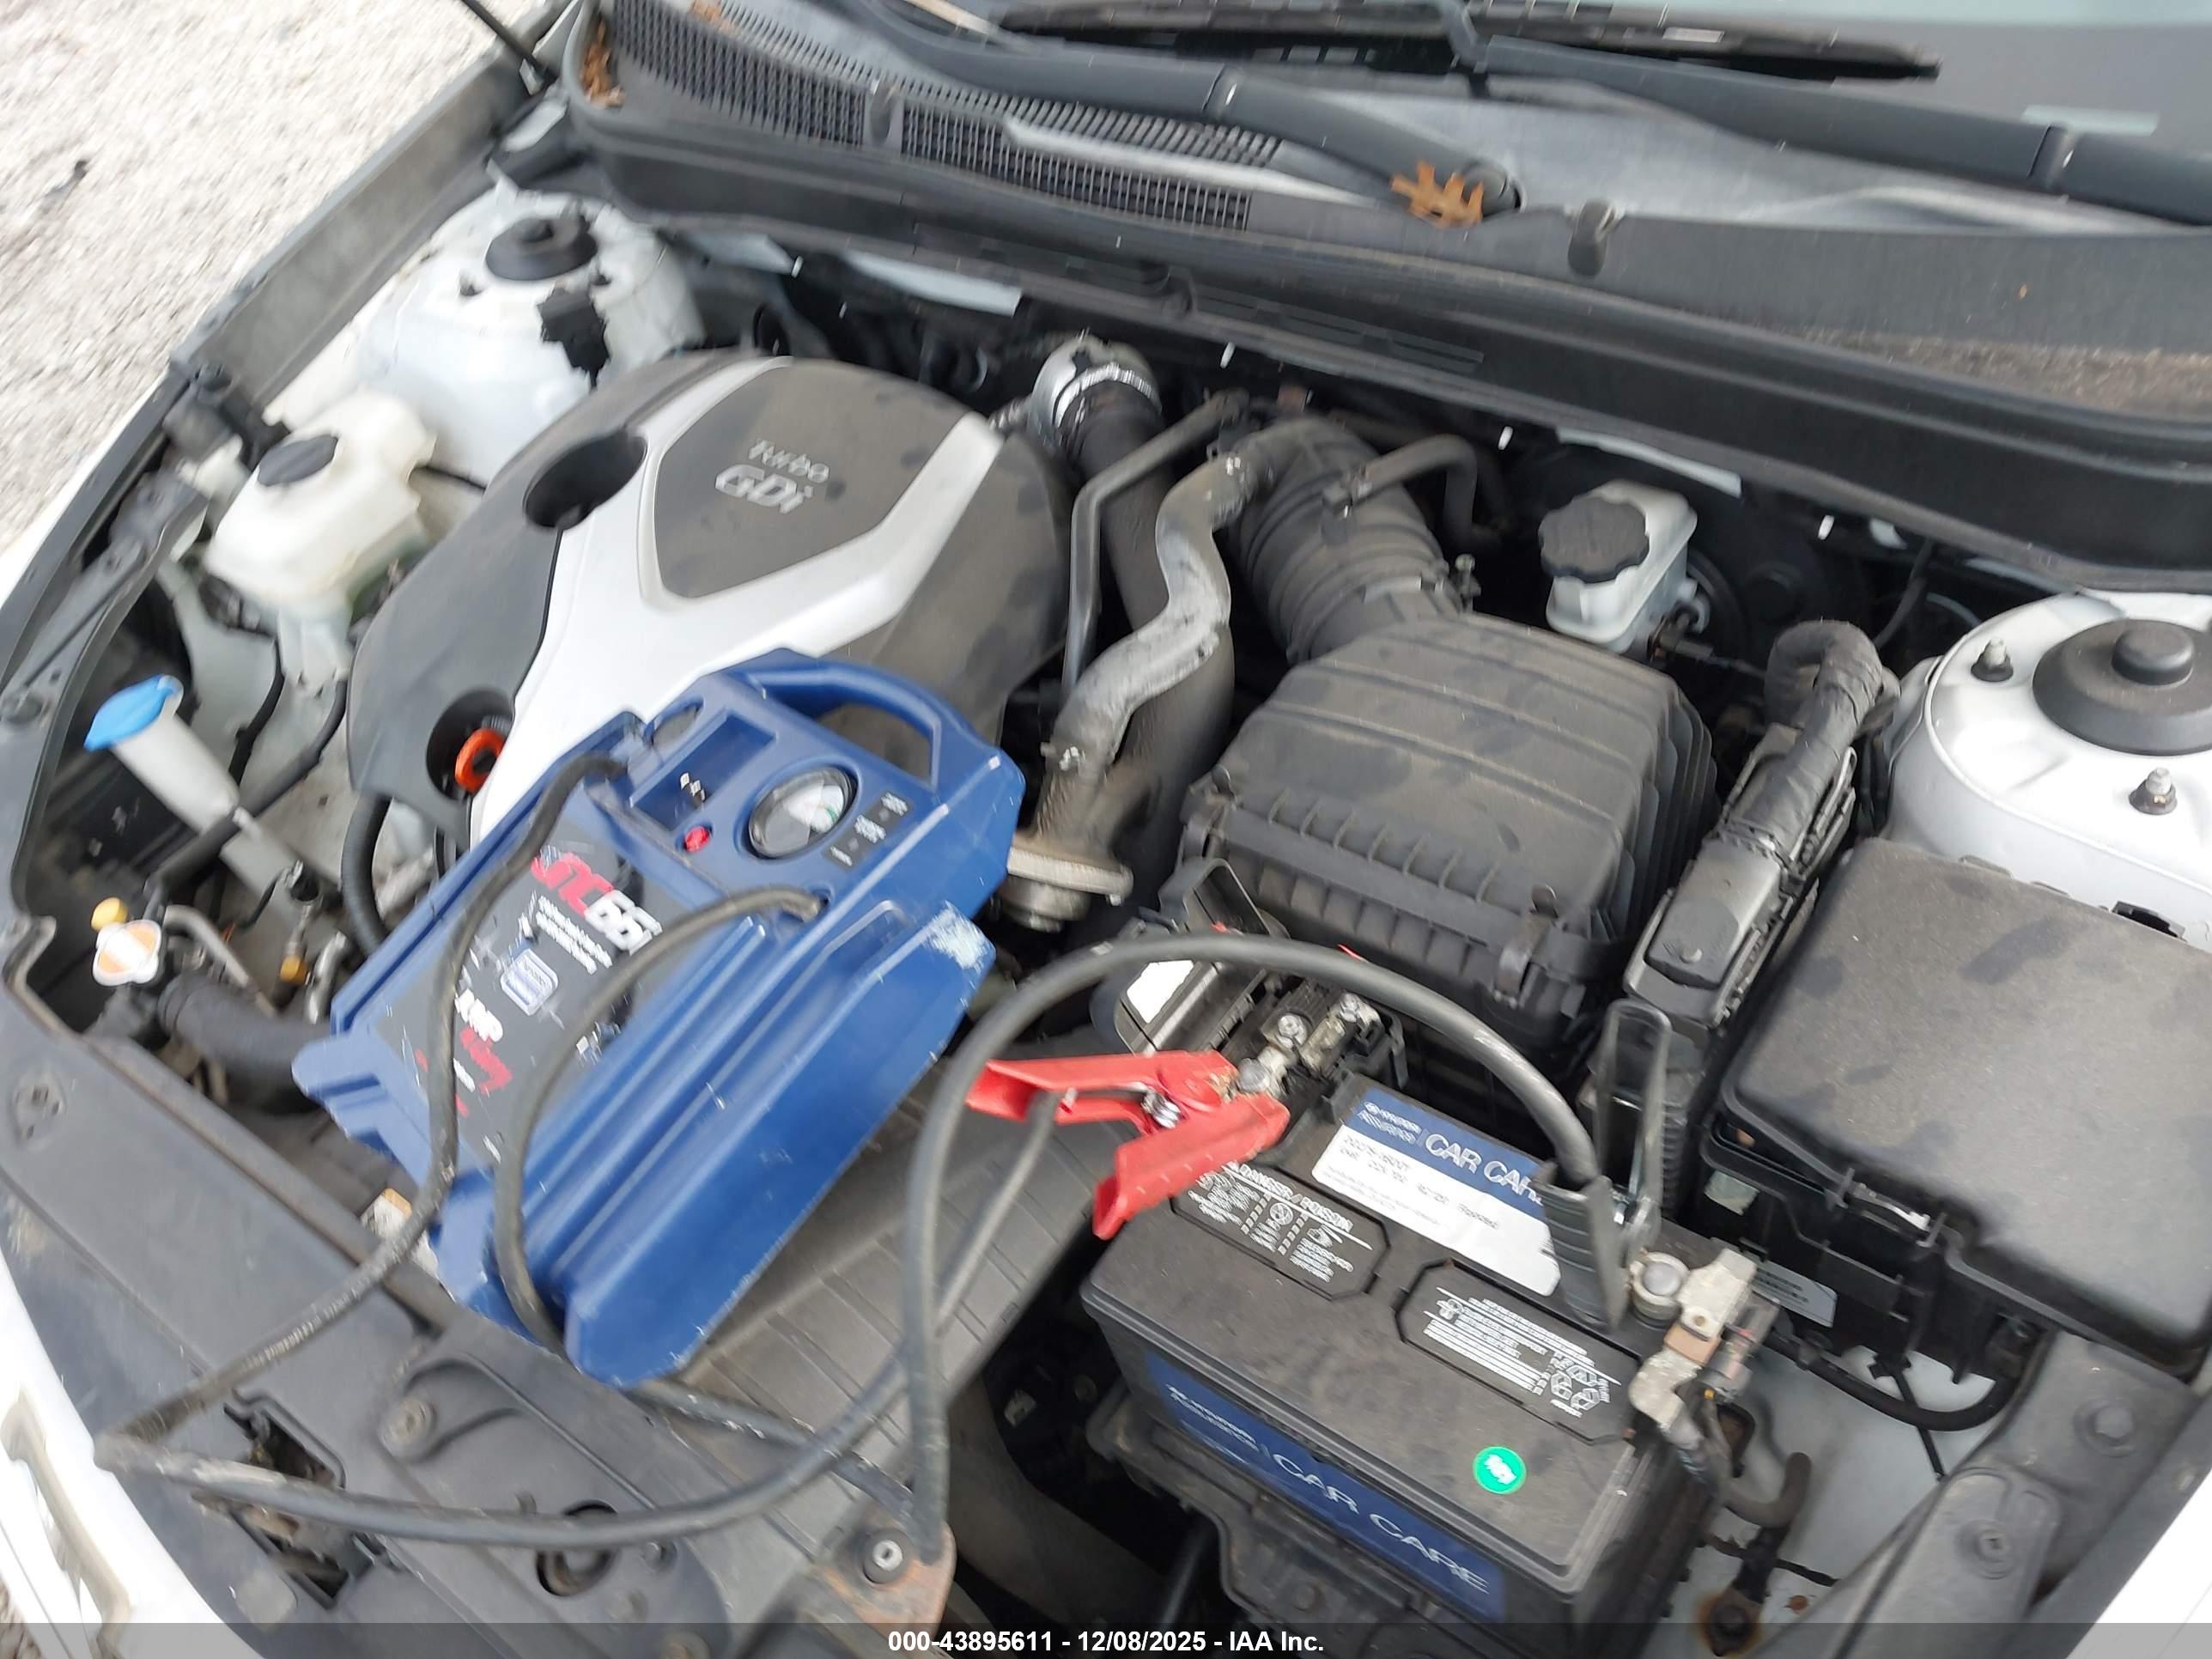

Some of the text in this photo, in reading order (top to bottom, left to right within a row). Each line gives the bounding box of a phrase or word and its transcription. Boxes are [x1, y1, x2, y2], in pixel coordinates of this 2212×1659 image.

[714, 464, 815, 515] GDi
[1425, 1133, 1483, 1175] CAR
[1483, 1160, 1545, 1207] CAR
[1272, 1453, 1491, 1595] CAR CARE
